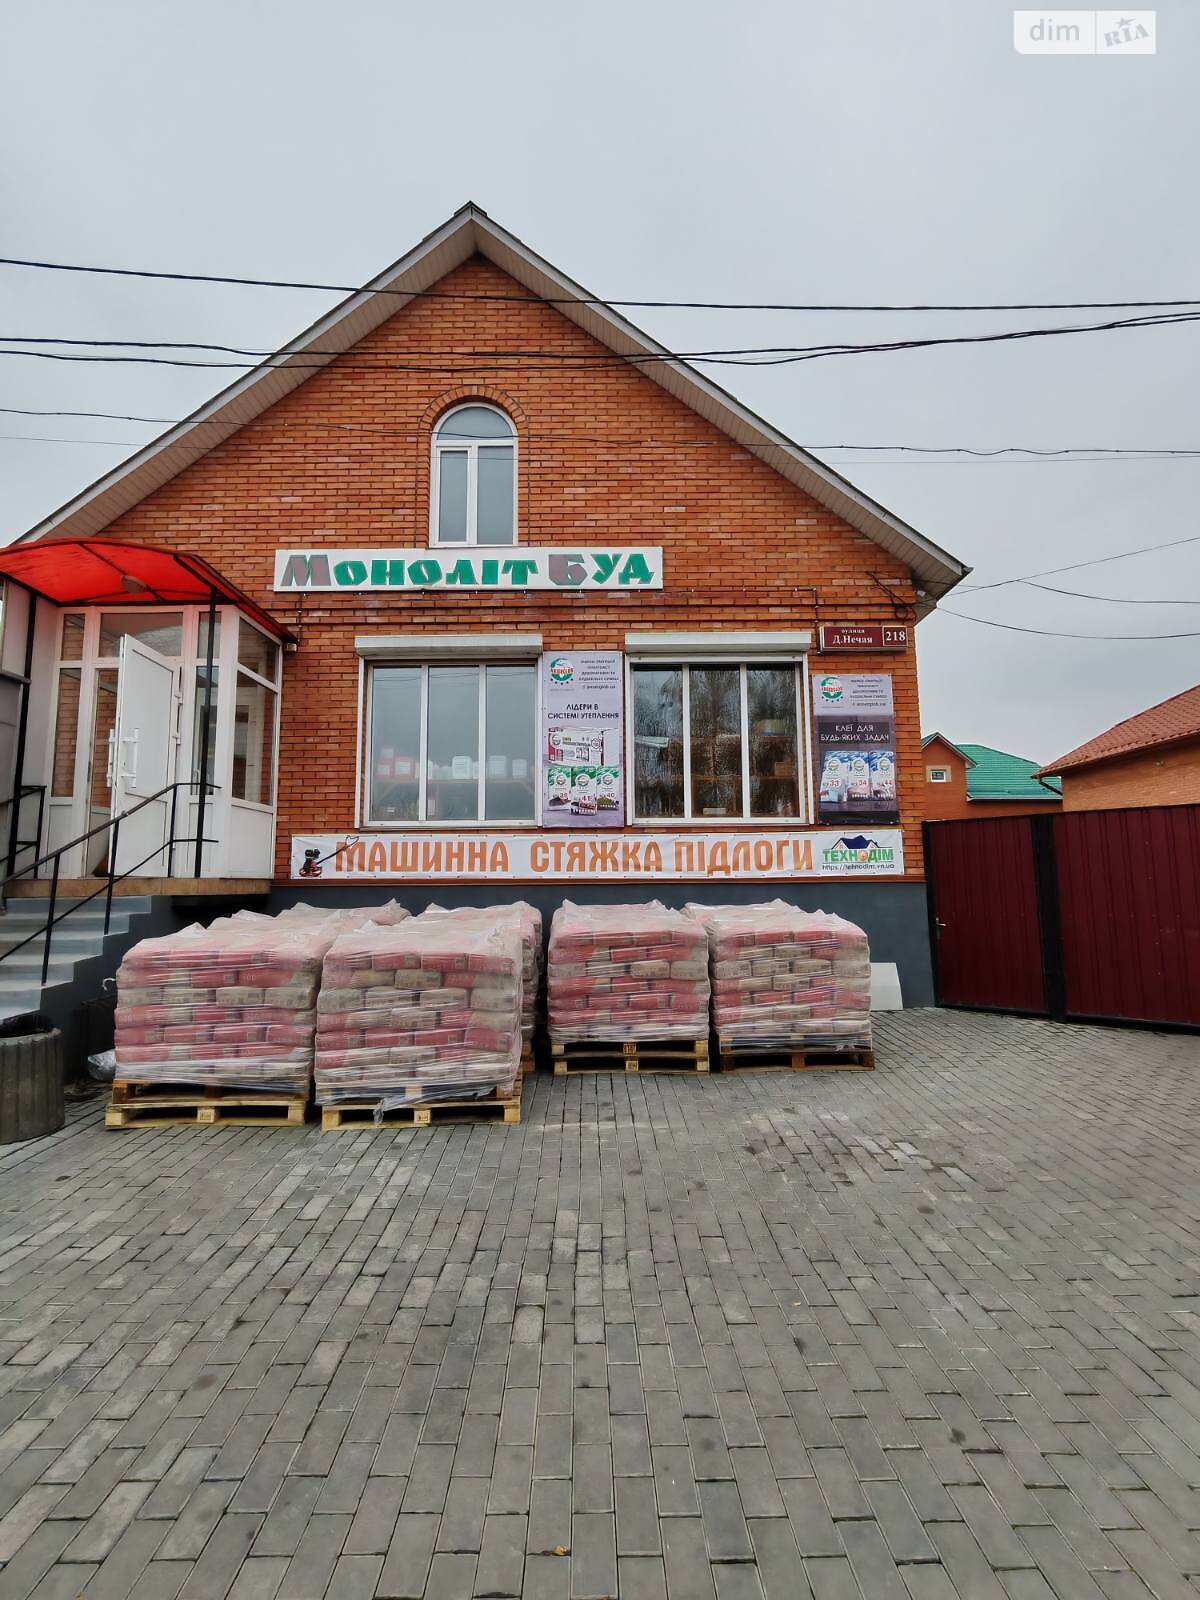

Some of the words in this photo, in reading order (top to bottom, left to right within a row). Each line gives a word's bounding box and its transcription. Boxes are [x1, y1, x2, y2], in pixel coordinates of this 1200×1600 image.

[832, 635, 873, 645] Д.Нечая
[886, 631, 906, 642] 218
[566, 703, 592, 711] ЛІДЕРИ
[594, 703, 599, 711] В
[548, 712, 579, 720] СИСТЕМІ
[580, 712, 620, 720] УТЕПЛЕННЯ
[856, 724, 874, 732] ДЛЯ
[864, 733, 889, 741] ЗАДАЧ
[335, 841, 509, 872] МАШИННА
[530, 841, 662, 872] СТЯЖКА
[674, 839, 813, 877] ПІДЛОГИ
